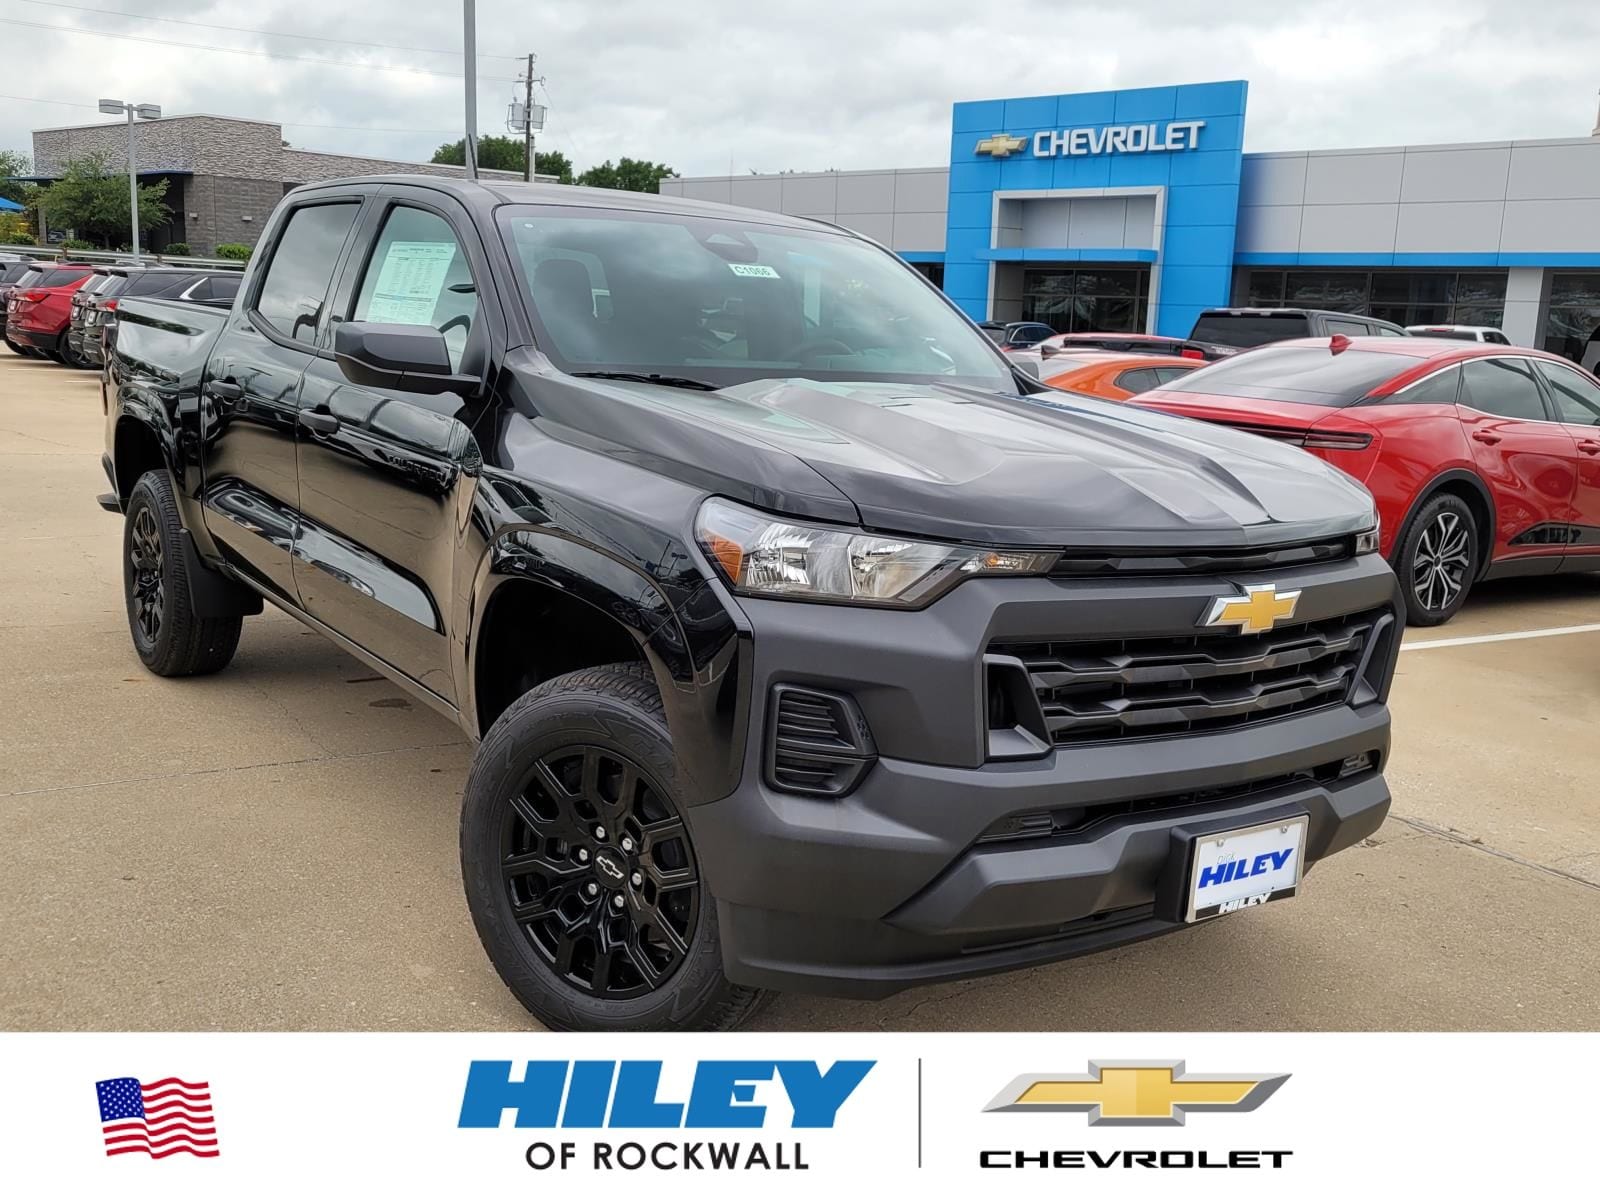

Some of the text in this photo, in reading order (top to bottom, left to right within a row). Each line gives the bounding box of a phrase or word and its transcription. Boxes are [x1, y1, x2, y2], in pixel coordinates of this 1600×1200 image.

[1034, 121, 1206, 157] CHEVROLET
[1198, 848, 1294, 889] HILEY
[1219, 893, 1271, 914] HILEY
